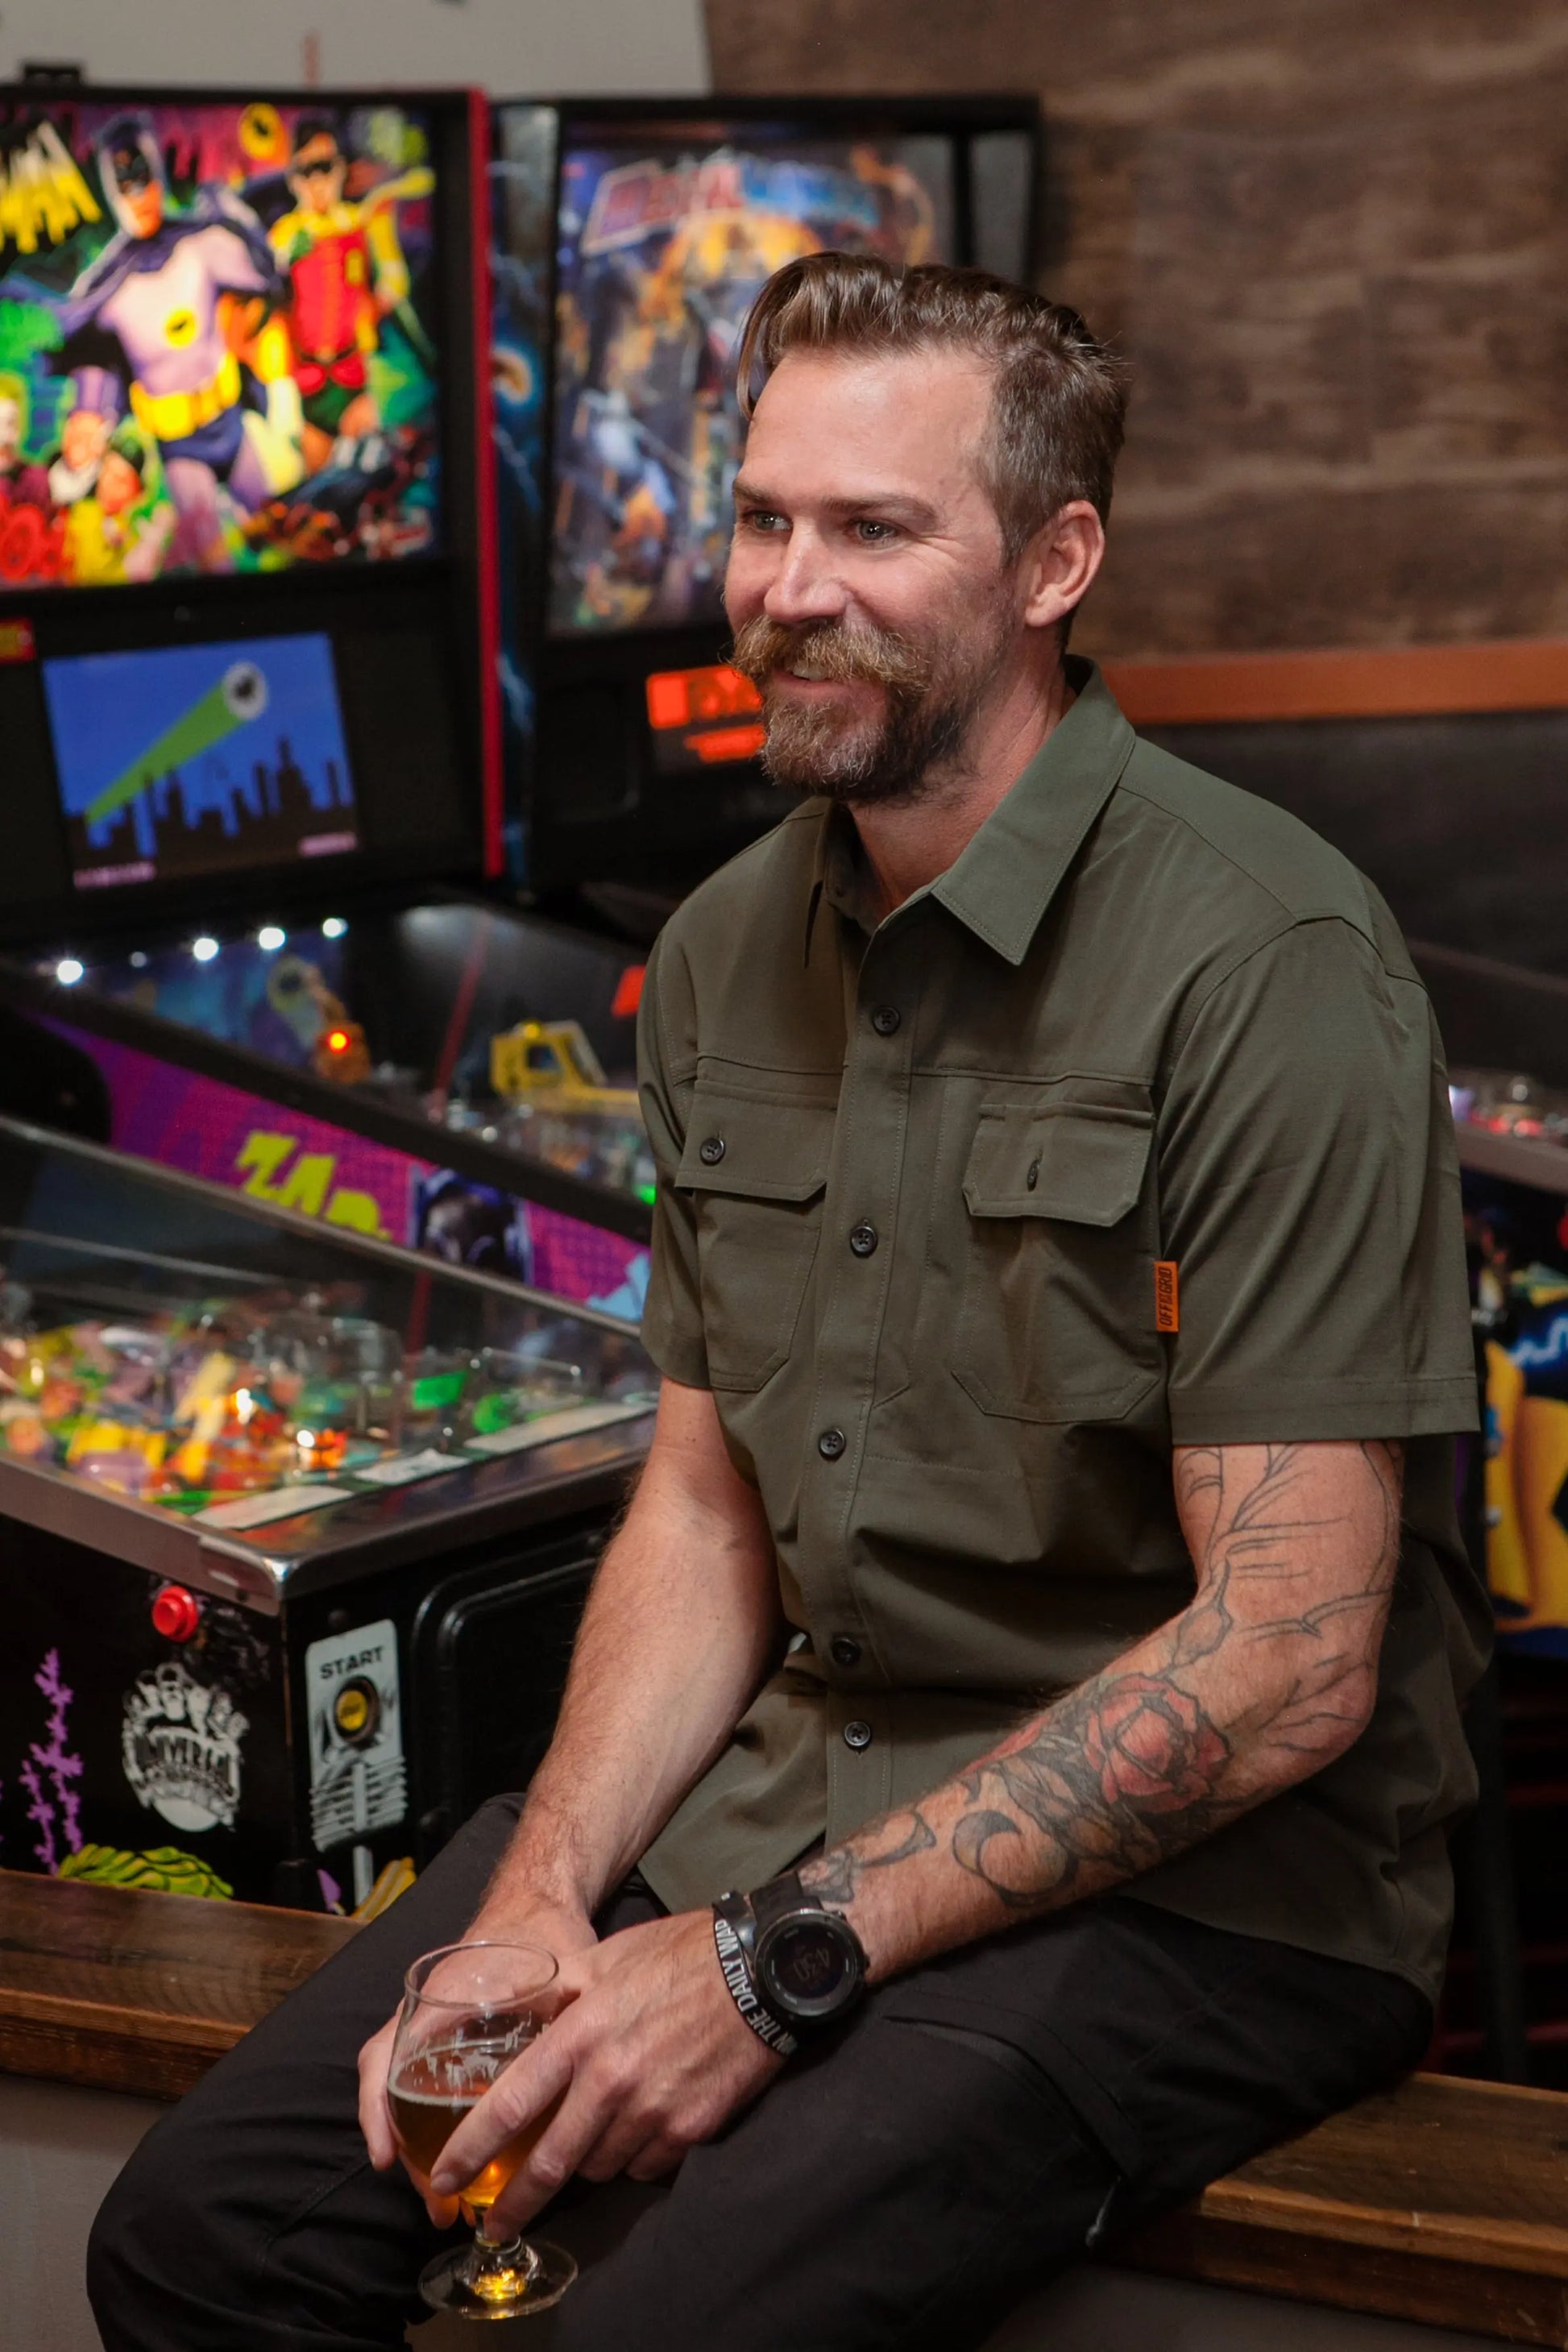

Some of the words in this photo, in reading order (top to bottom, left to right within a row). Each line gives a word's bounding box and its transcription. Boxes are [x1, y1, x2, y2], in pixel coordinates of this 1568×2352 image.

[320, 1645, 384, 1679] START
[722, 1957, 758, 2013] DAILY
[746, 2008, 782, 2043] THE
